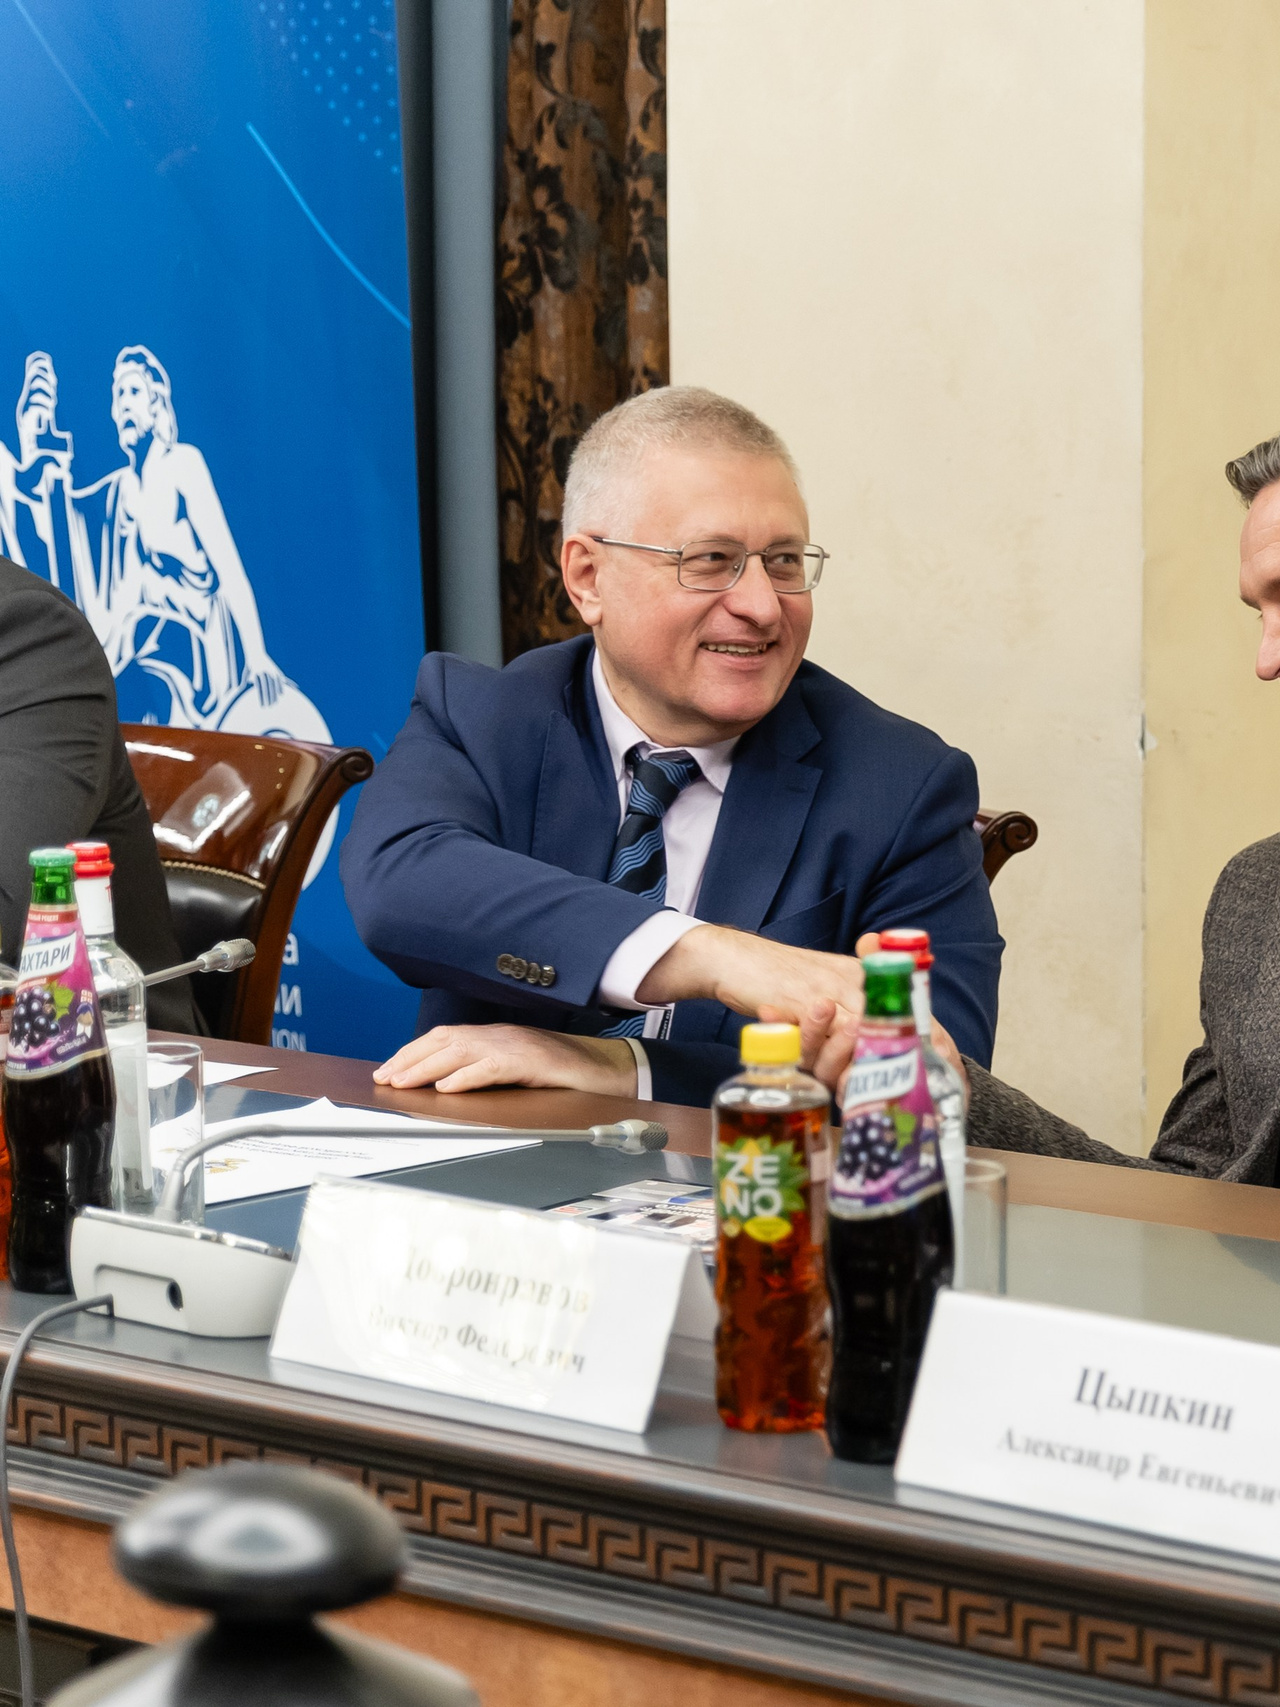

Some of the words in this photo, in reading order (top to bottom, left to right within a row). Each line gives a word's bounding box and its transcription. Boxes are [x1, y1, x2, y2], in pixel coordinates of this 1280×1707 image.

[725, 1152, 780, 1186] ZE
[725, 1186, 784, 1218] NO
[1074, 1366, 1235, 1432] Цыпкин
[997, 1427, 1131, 1481] Александр
